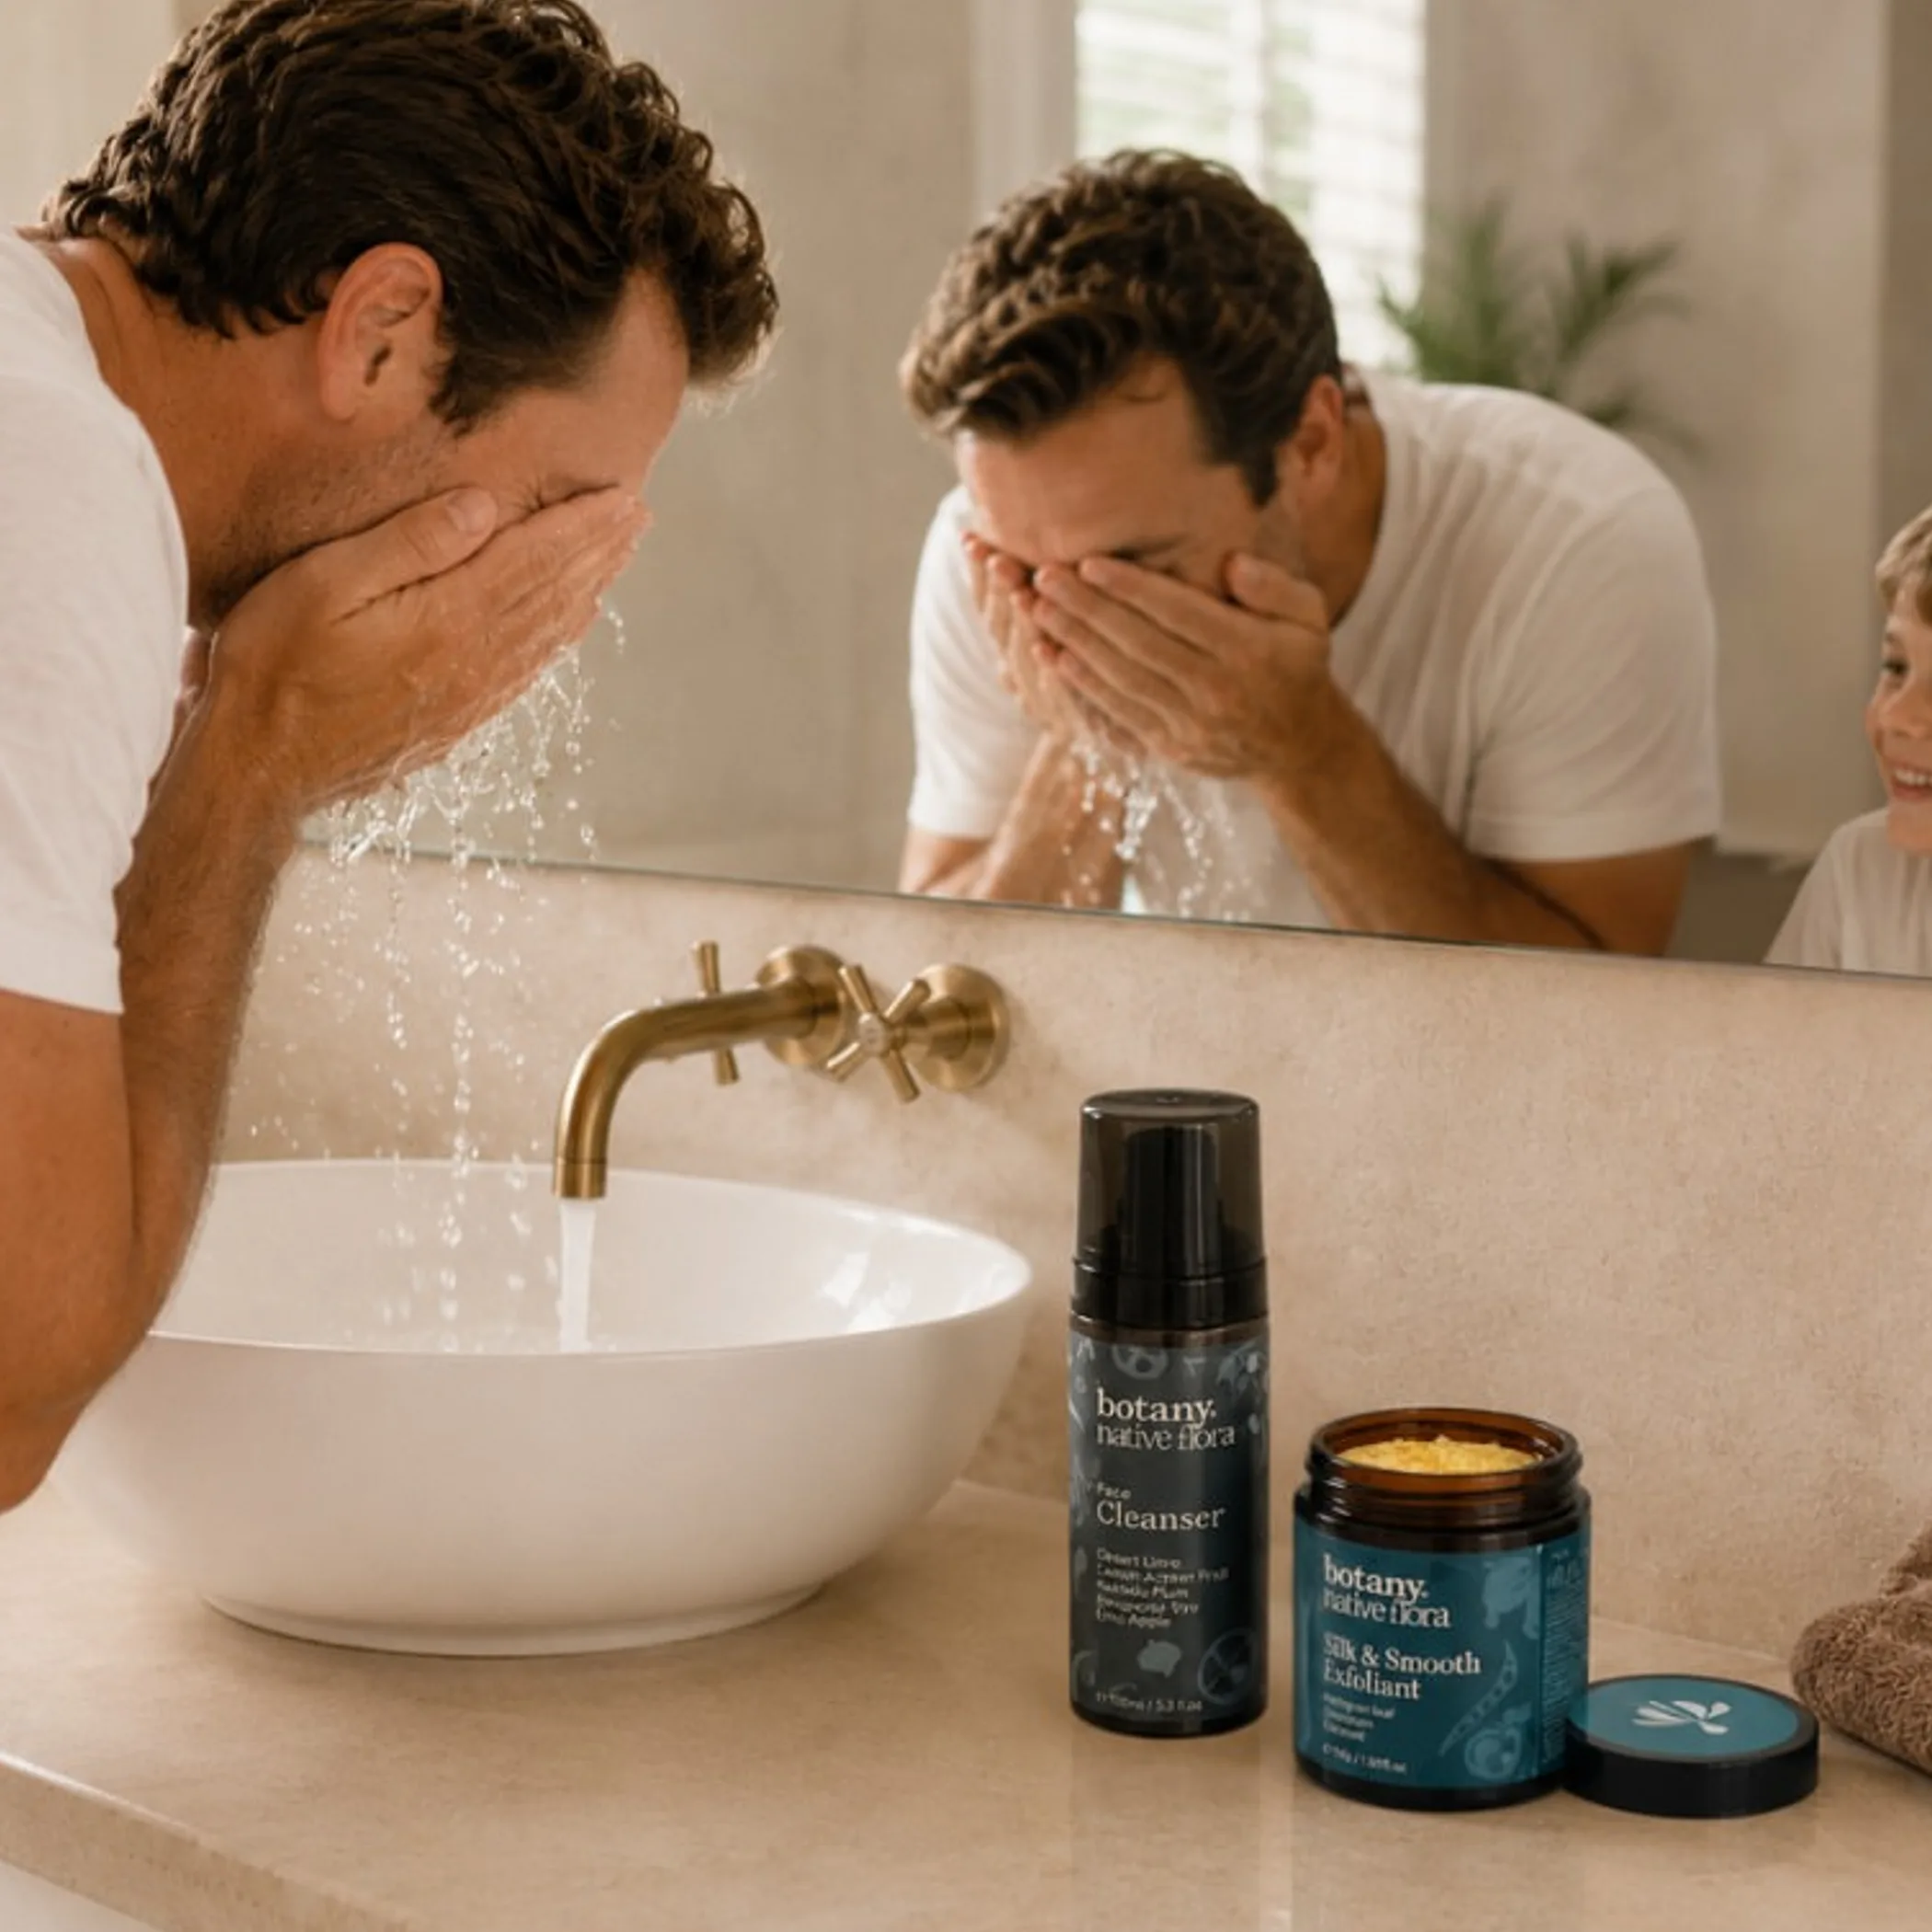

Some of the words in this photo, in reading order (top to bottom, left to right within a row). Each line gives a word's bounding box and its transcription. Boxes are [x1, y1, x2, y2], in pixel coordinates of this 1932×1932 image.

[1097, 1386, 1217, 1430] botany.
[1097, 1423, 1173, 1451] native
[1178, 1423, 1236, 1451] flora
[1097, 1500, 1226, 1531] Cleanser
[1322, 1553, 1430, 1605] botany.
[1322, 1587, 1386, 1623] native
[1389, 1597, 1451, 1628] flora
[1323, 1631, 1358, 1663] Silk
[1361, 1643, 1380, 1668] &
[1384, 1648, 1482, 1674] Smooth
[1323, 1658, 1421, 1700] Exfoliant
